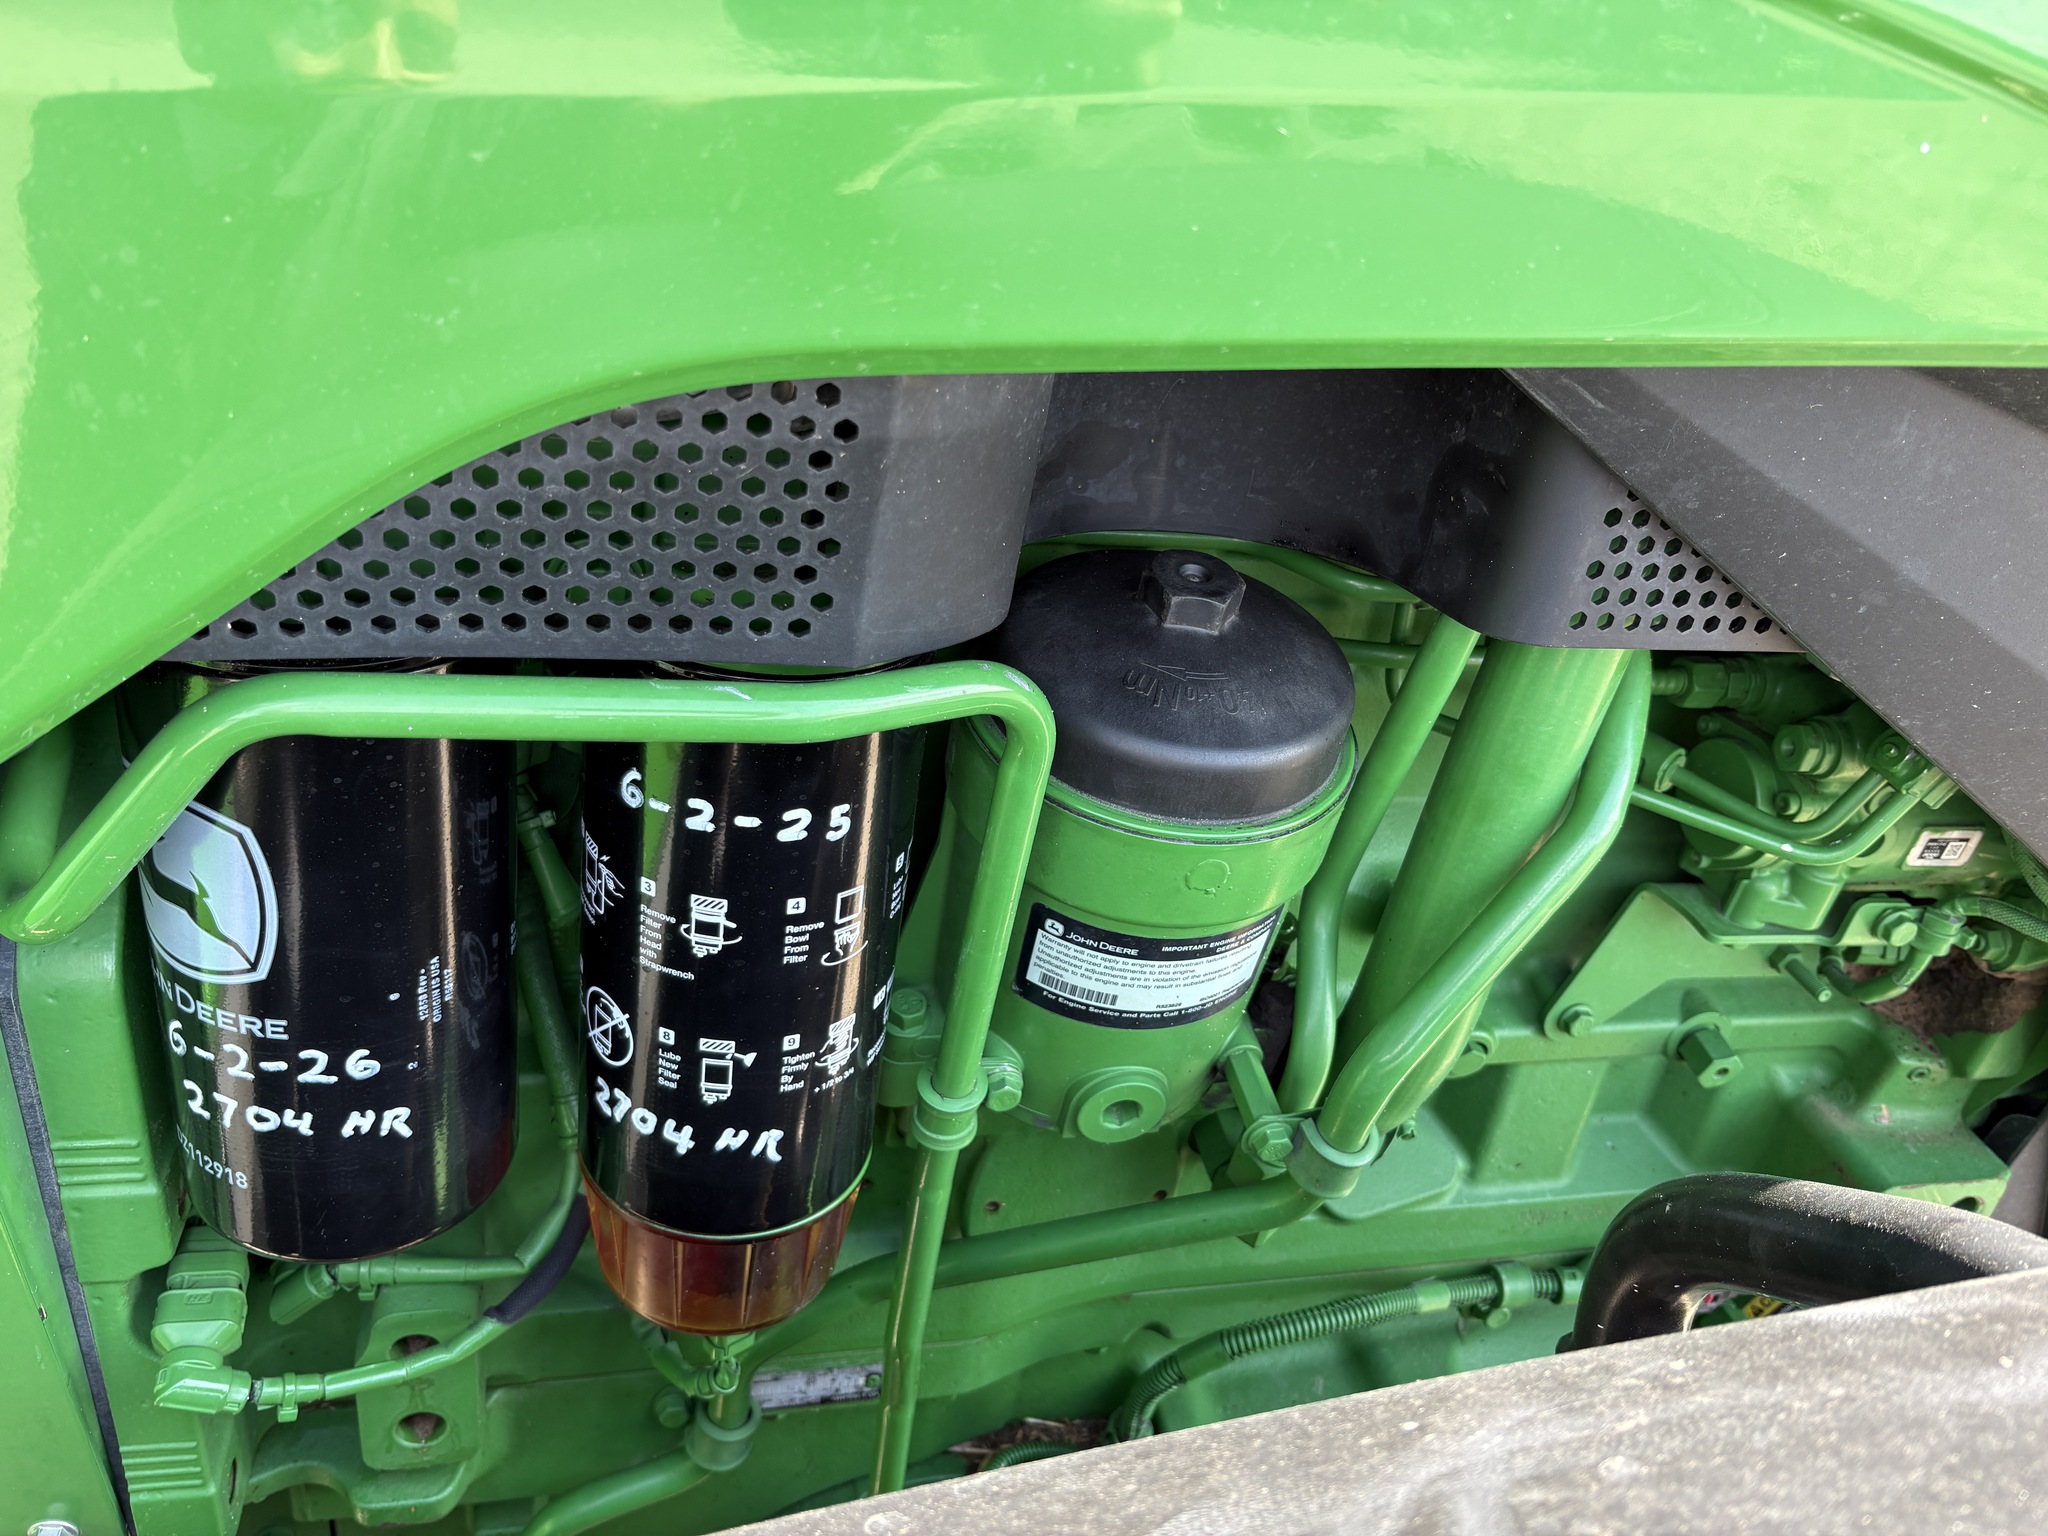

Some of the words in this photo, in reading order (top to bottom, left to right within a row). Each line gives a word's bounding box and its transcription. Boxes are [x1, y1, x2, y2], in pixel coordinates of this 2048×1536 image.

[621, 767, 851, 842] 6-2-25
[640, 904, 676, 924] Remove
[640, 914, 662, 930] Filter
[640, 924, 662, 940] From
[785, 921, 825, 934] Remove
[639, 935, 662, 951] Head
[784, 933, 810, 944] Bowl
[1065, 931, 1098, 948] JOHN
[1099, 941, 1139, 956] DEERE
[1161, 943, 1208, 952] IMPORTANT
[1209, 937, 1237, 948] ENGINE
[639, 946, 657, 959] with
[784, 944, 809, 954] From
[1040, 932, 1072, 951] Warranty
[1073, 947, 1085, 956] will
[1086, 951, 1099, 959] not
[1100, 954, 1120, 965] apply
[1131, 962, 1156, 970] engine
[1173, 961, 1204, 969] drivetrain
[1216, 942, 1240, 953] DEERE
[783, 954, 808, 965] Filter
[1037, 947, 1082, 970] Unauthorized
[1084, 966, 1127, 980] adjustments
[1039, 940, 1054, 951] from
[1056, 948, 1101, 968] unauthorized
[1103, 963, 1147, 975] adjustments
[430, 955, 440, 978] USA
[639, 956, 695, 981] Strapwrench
[1035, 955, 1070, 973] applicable
[1080, 971, 1093, 980] this
[1094, 977, 1119, 986] engine
[174, 982, 290, 1041] DEERE
[432, 988, 443, 1023] ORIGIN
[1042, 990, 1057, 1000] For
[1058, 997, 1087, 1010] Engine
[1088, 1006, 1120, 1017] Service
[168, 1019, 382, 1084] 6-2-26
[659, 1048, 682, 1062] Lube
[782, 1051, 816, 1065] Tighten
[658, 1058, 679, 1071] New
[781, 1062, 810, 1074] Firmly
[658, 1067, 681, 1080] Filter
[780, 1074, 794, 1084] By
[658, 1076, 677, 1089] Seal
[779, 1080, 805, 1093] Hand
[821, 1079, 834, 1090] 1/2
[834, 1075, 843, 1084] to
[183, 1079, 315, 1137] 2704
[341, 1106, 414, 1139] HR
[595, 1075, 696, 1155] 2704
[714, 1126, 784, 1163] HR
